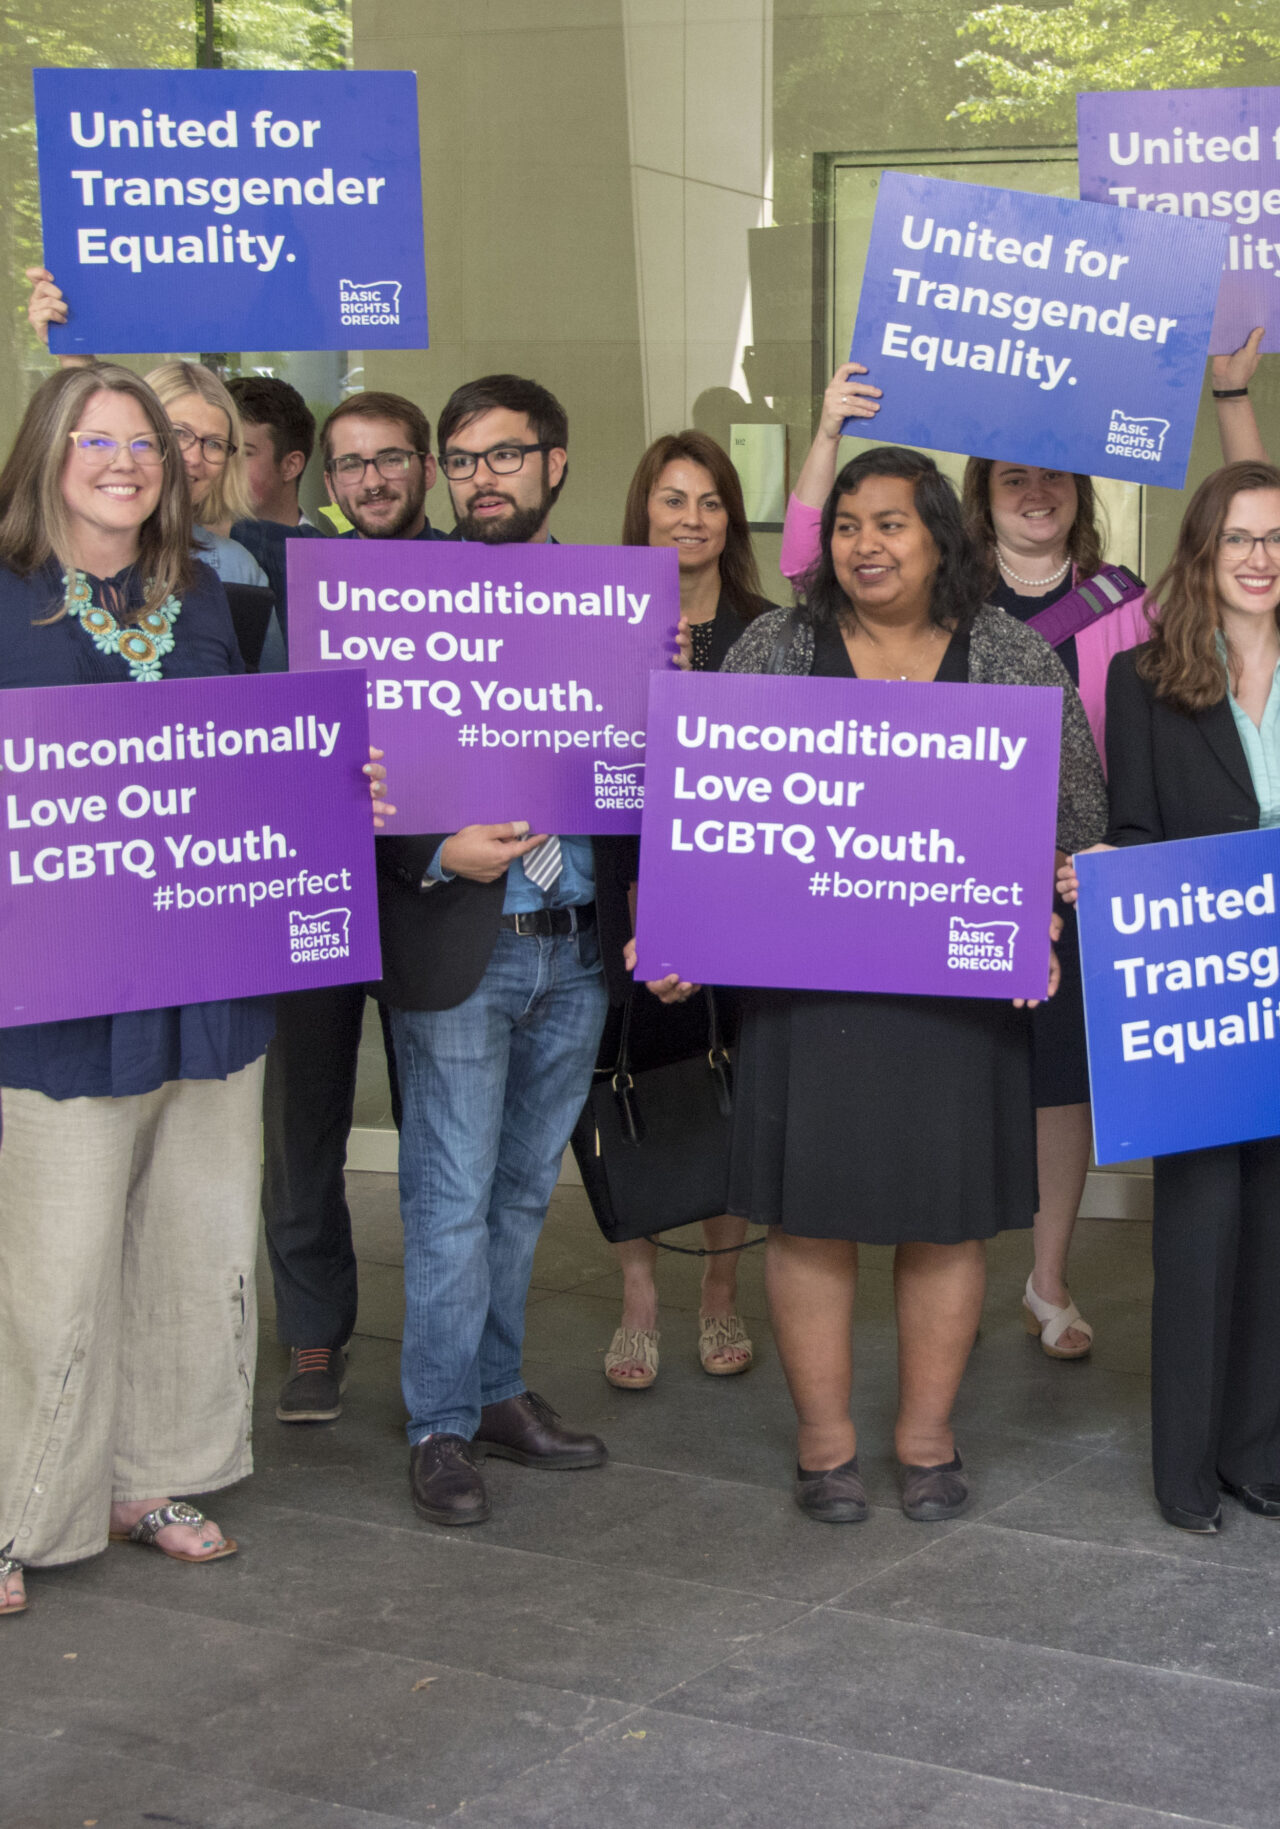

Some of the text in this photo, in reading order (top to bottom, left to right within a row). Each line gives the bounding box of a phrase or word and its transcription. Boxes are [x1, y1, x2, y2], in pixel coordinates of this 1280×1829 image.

[70, 108, 321, 149] United for
[1109, 127, 1259, 165] United
[71, 168, 385, 214] Transgender
[78, 224, 297, 273] Equality.
[902, 216, 1129, 280] United for
[340, 291, 382, 302] BASIC
[340, 303, 391, 314] RIGHTS
[893, 269, 1178, 343] Transgender
[341, 315, 400, 326] OREGON
[882, 323, 1077, 390] Equality.
[1107, 432, 1155, 449] RIGHTS
[1109, 421, 1149, 437] BASIC
[1105, 444, 1162, 462] OREGON
[319, 581, 651, 624] Unconditionally
[320, 630, 504, 662] Love Our
[367, 680, 603, 717] BTQ Youth.
[4, 716, 342, 773] Unconditionally
[458, 723, 646, 753] #bornperfec
[677, 716, 1027, 770] Unconditionally
[594, 773, 637, 785] BASIC
[594, 785, 645, 797] RIGHTS
[674, 767, 866, 807] Love Our
[7, 785, 196, 829] Love Our
[595, 798, 645, 809] OREGO
[10, 825, 298, 890] LGBTQ Youth.
[672, 819, 965, 865] LGBTQ Youth.
[153, 868, 352, 911] #bornperfect
[808, 872, 1023, 907] #bornperfect
[1111, 873, 1275, 934] United
[290, 921, 331, 937] BASIC
[290, 933, 341, 950] RIGHTS
[948, 930, 995, 945] BASIC
[291, 945, 350, 964] OREGON
[947, 943, 1004, 959] RIGHTS
[947, 957, 1014, 972] OREGON
